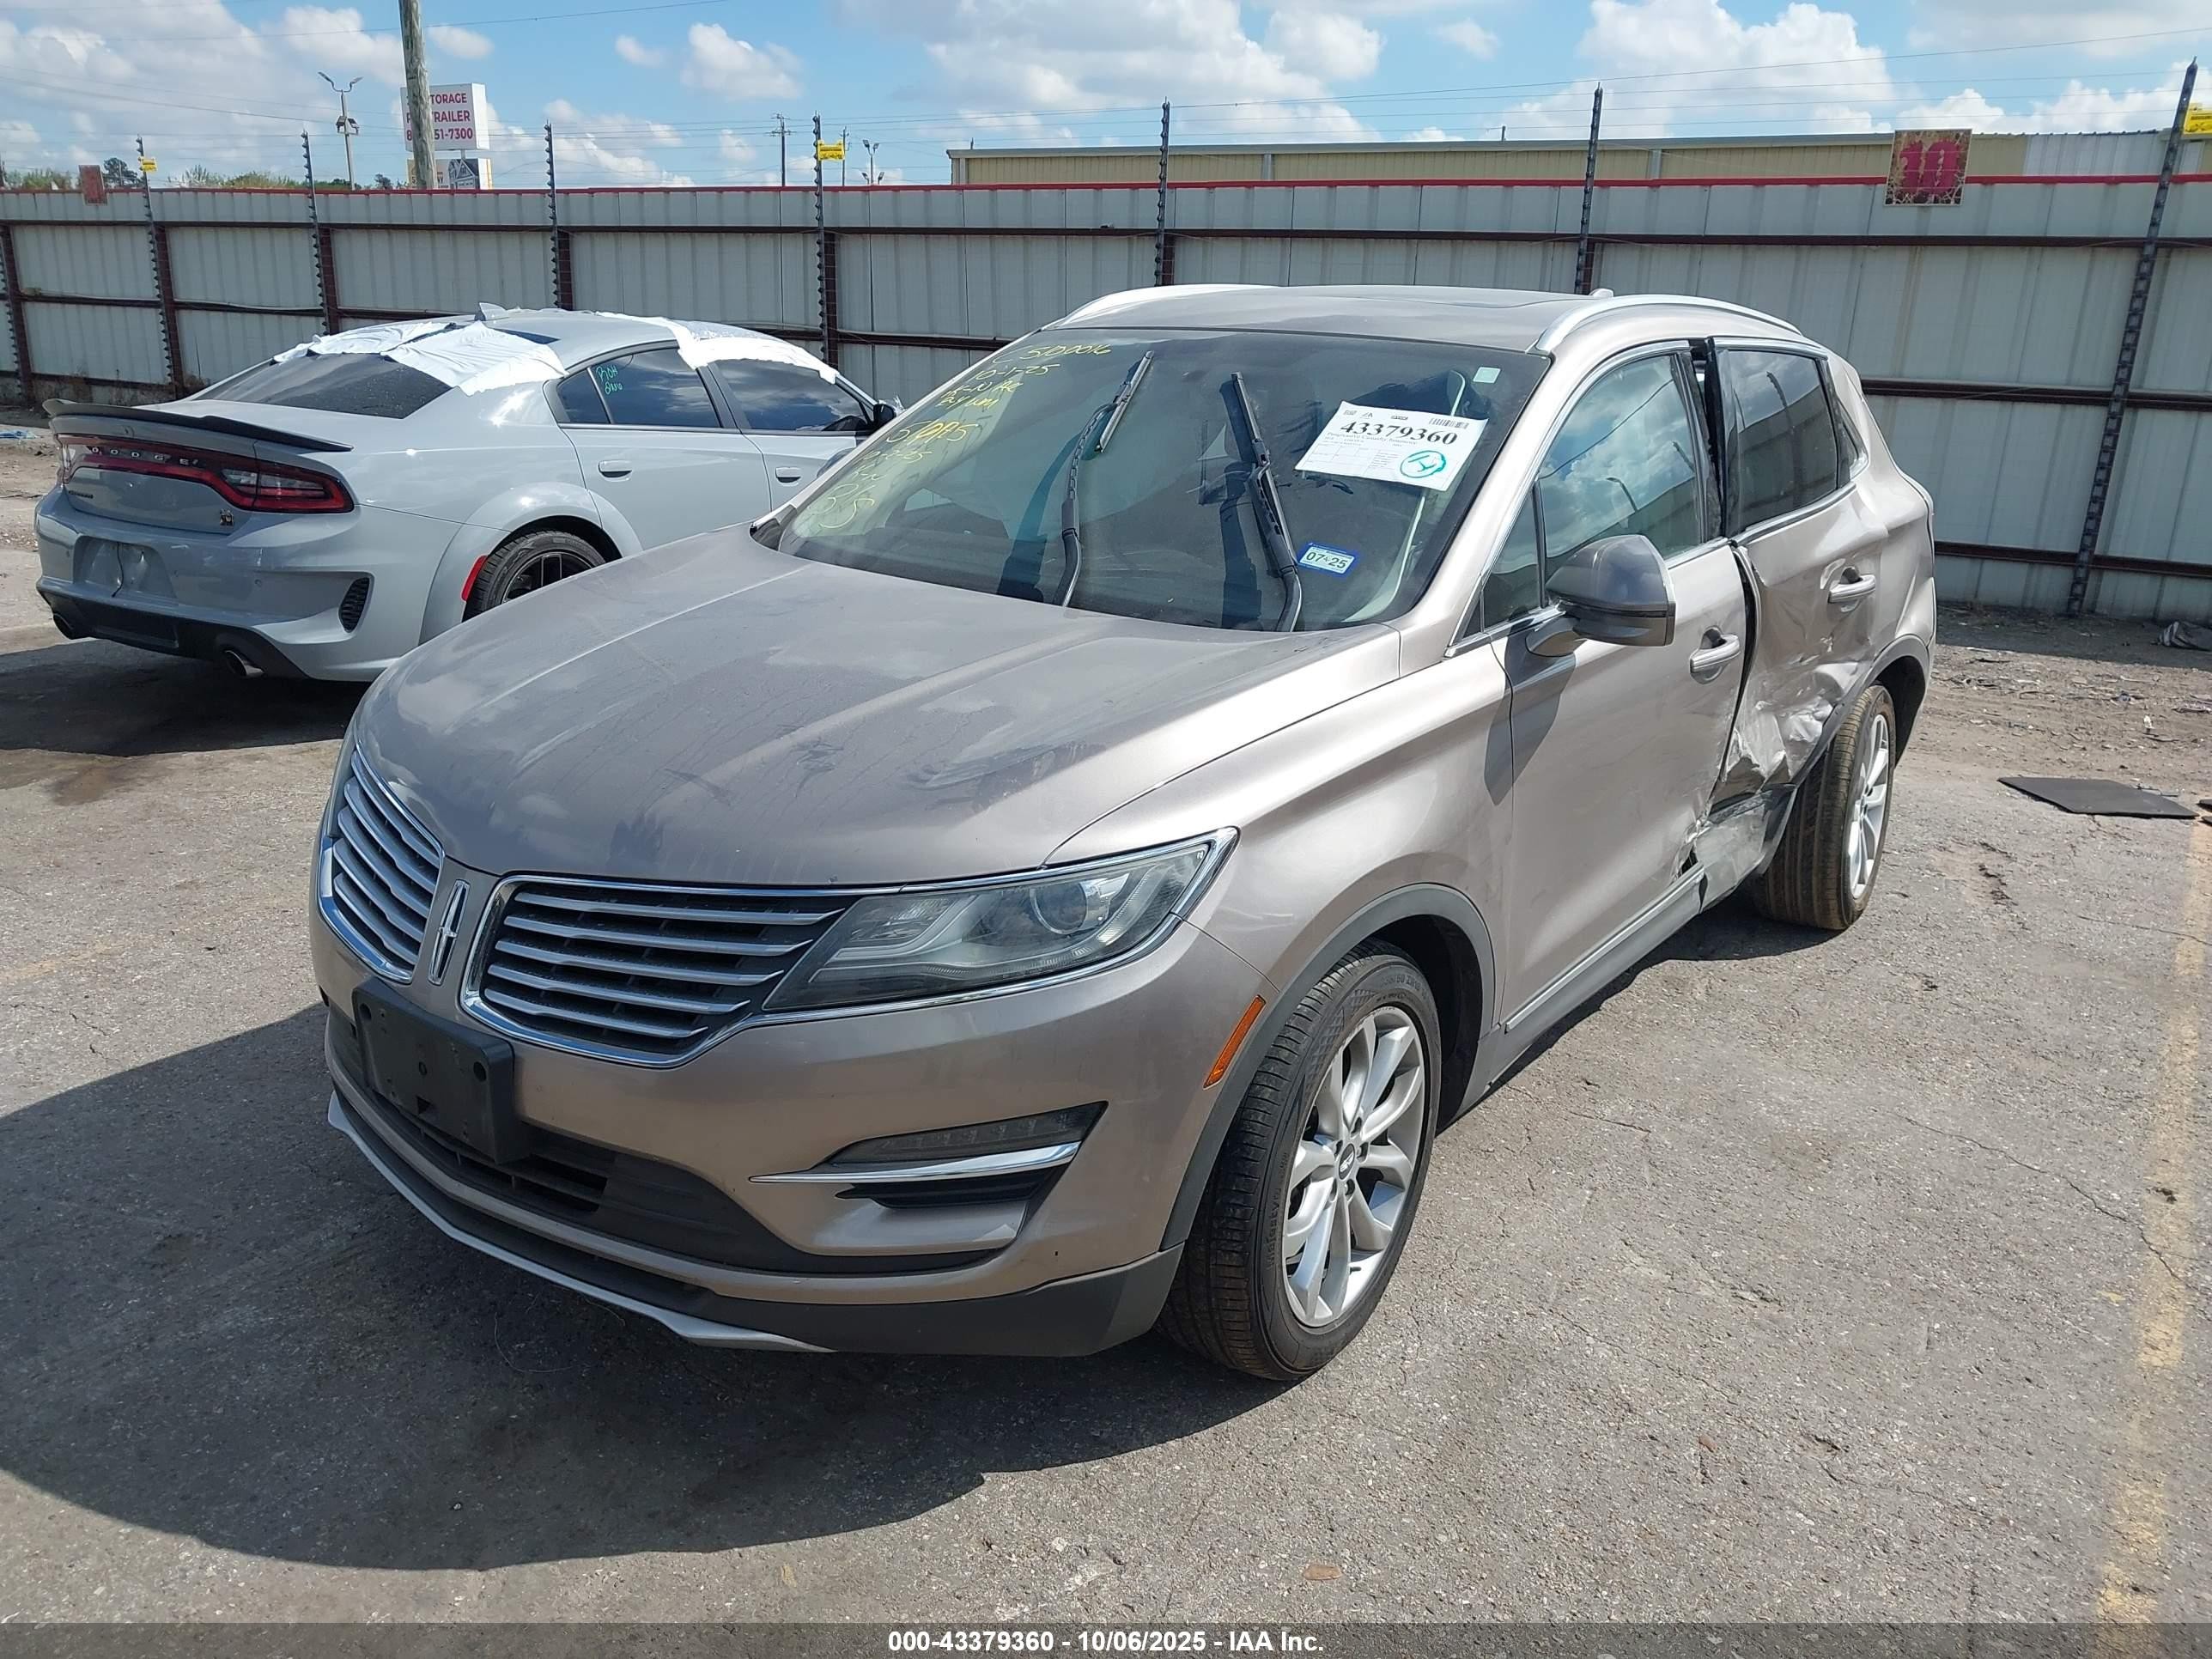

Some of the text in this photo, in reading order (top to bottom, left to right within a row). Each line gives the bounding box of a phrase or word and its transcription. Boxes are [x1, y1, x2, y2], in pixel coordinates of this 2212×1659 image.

[430, 93, 467, 105] TORAGE
[432, 110, 471, 123] RAILER
[1340, 421, 1458, 445] 43379360
